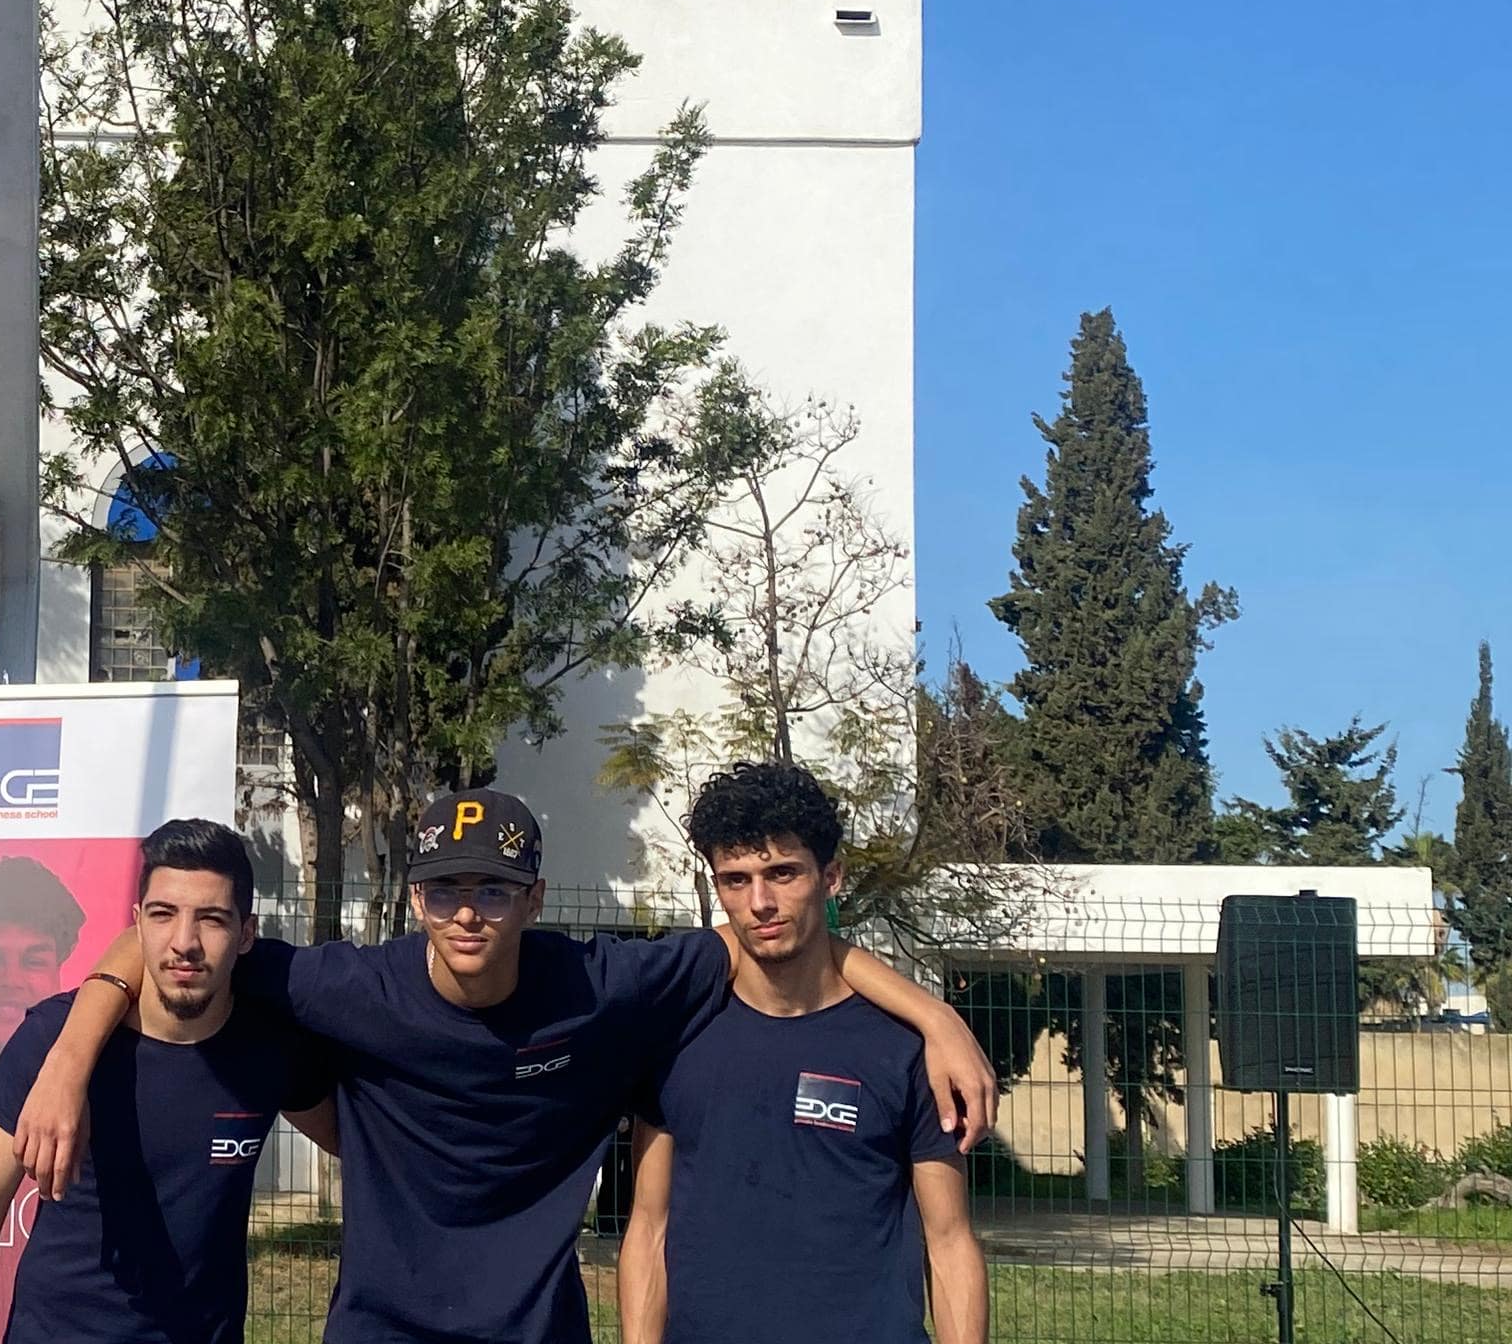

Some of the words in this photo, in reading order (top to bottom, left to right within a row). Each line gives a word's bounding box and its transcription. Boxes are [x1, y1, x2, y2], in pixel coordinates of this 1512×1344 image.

[24, 809, 58, 819] school
[453, 801, 485, 840] P
[515, 1054, 571, 1079] EDGE
[794, 1097, 858, 1126] EDGE
[211, 1139, 261, 1157] EDGE
